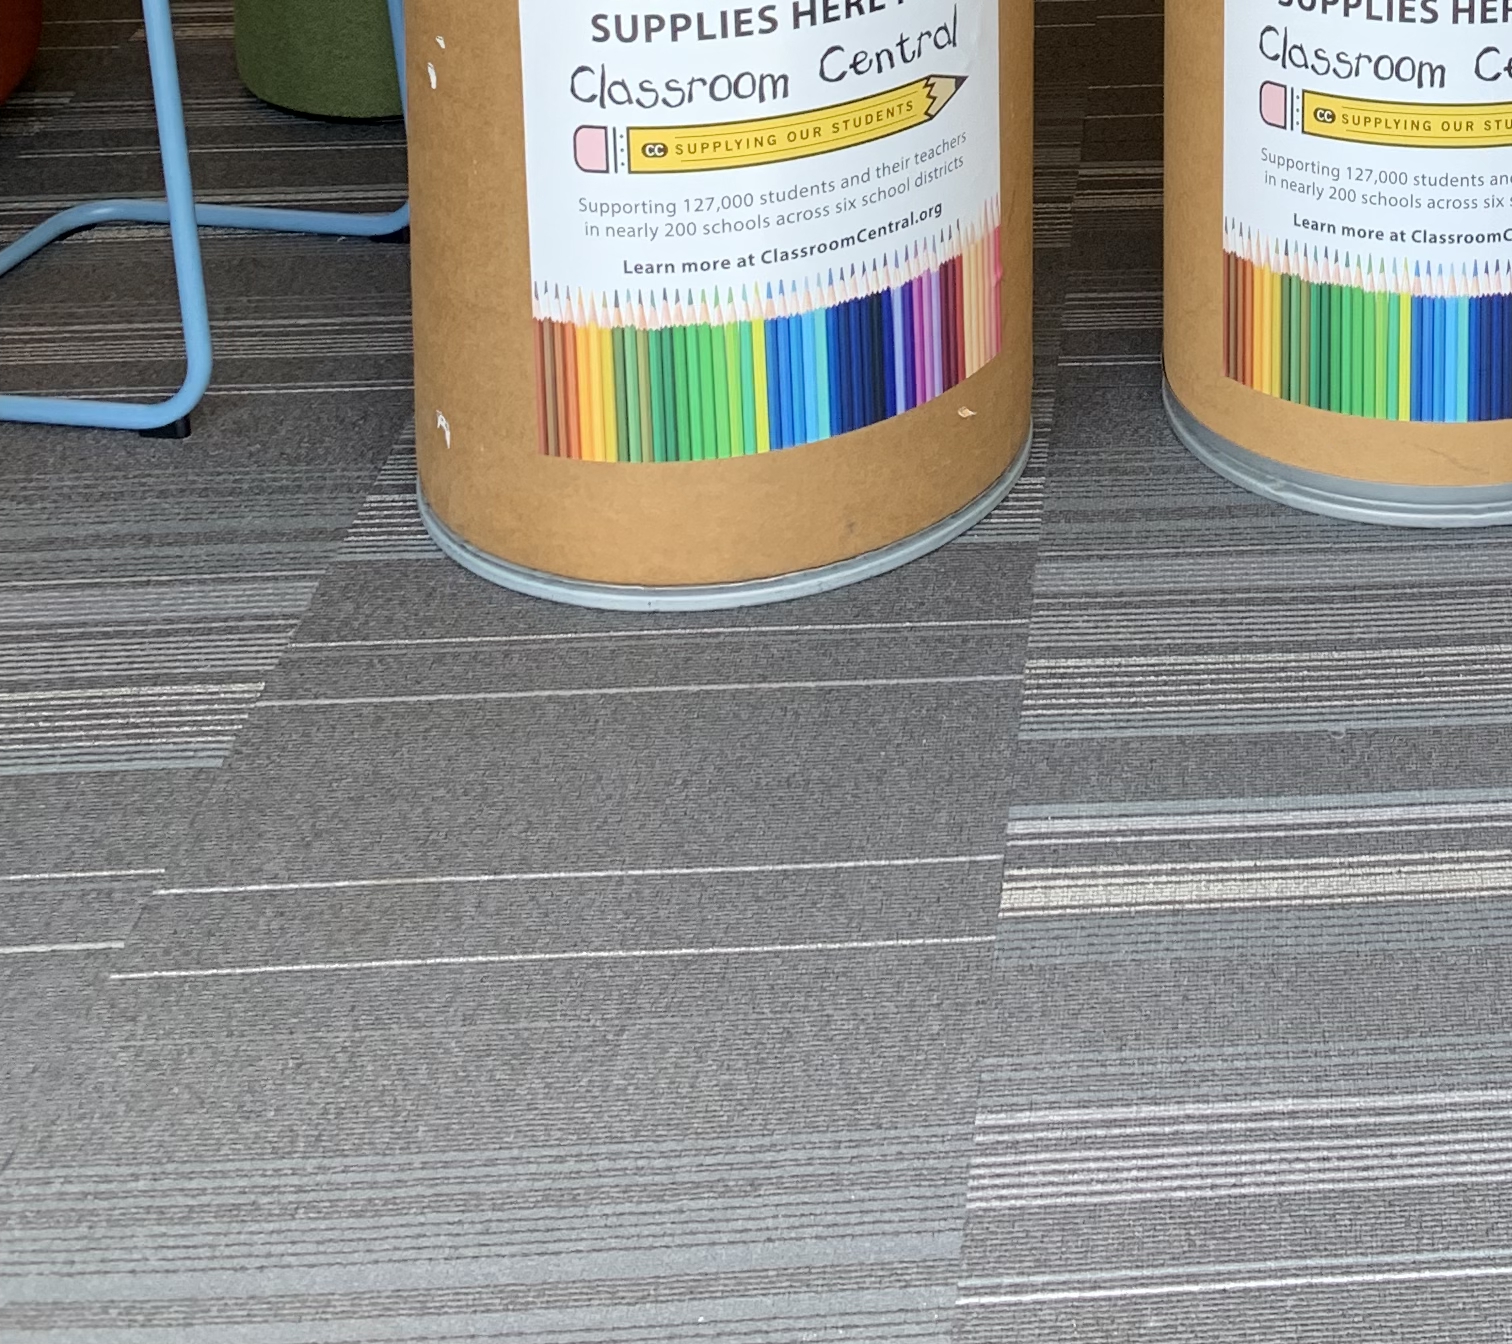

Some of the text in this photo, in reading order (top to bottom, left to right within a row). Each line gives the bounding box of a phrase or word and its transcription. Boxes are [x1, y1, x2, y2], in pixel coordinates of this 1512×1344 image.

[591, 5, 778, 43] SUPPLIES
[570, 4, 957, 109] Classroom Central
[1259, 25, 1446, 89] Classroom
[645, 100, 913, 157] CC SUPPLYING OUR STUDENTS
[1316, 109, 1333, 123] CC
[1342, 113, 1431, 131] SUPPLYING
[1441, 121, 1474, 132] OUR
[579, 132, 966, 218] Supporting 127,000 students and their teachers
[1261, 147, 1340, 182] Supporting
[1347, 166, 1408, 186] 127,000
[1413, 172, 1485, 187] students
[1265, 170, 1276, 186] in
[1281, 178, 1325, 201] nearly
[1329, 186, 1356, 203] 200
[1361, 191, 1422, 209] schools
[1427, 198, 1478, 210] across
[1483, 194, 1504, 209] six
[585, 156, 963, 242] in nearly 200 schools across six school districts
[623, 203, 942, 274] Learn more at ClassroomCentral.org
[1294, 213, 1336, 234] Learn
[1341, 226, 1384, 241] more
[1389, 230, 1406, 243] at
